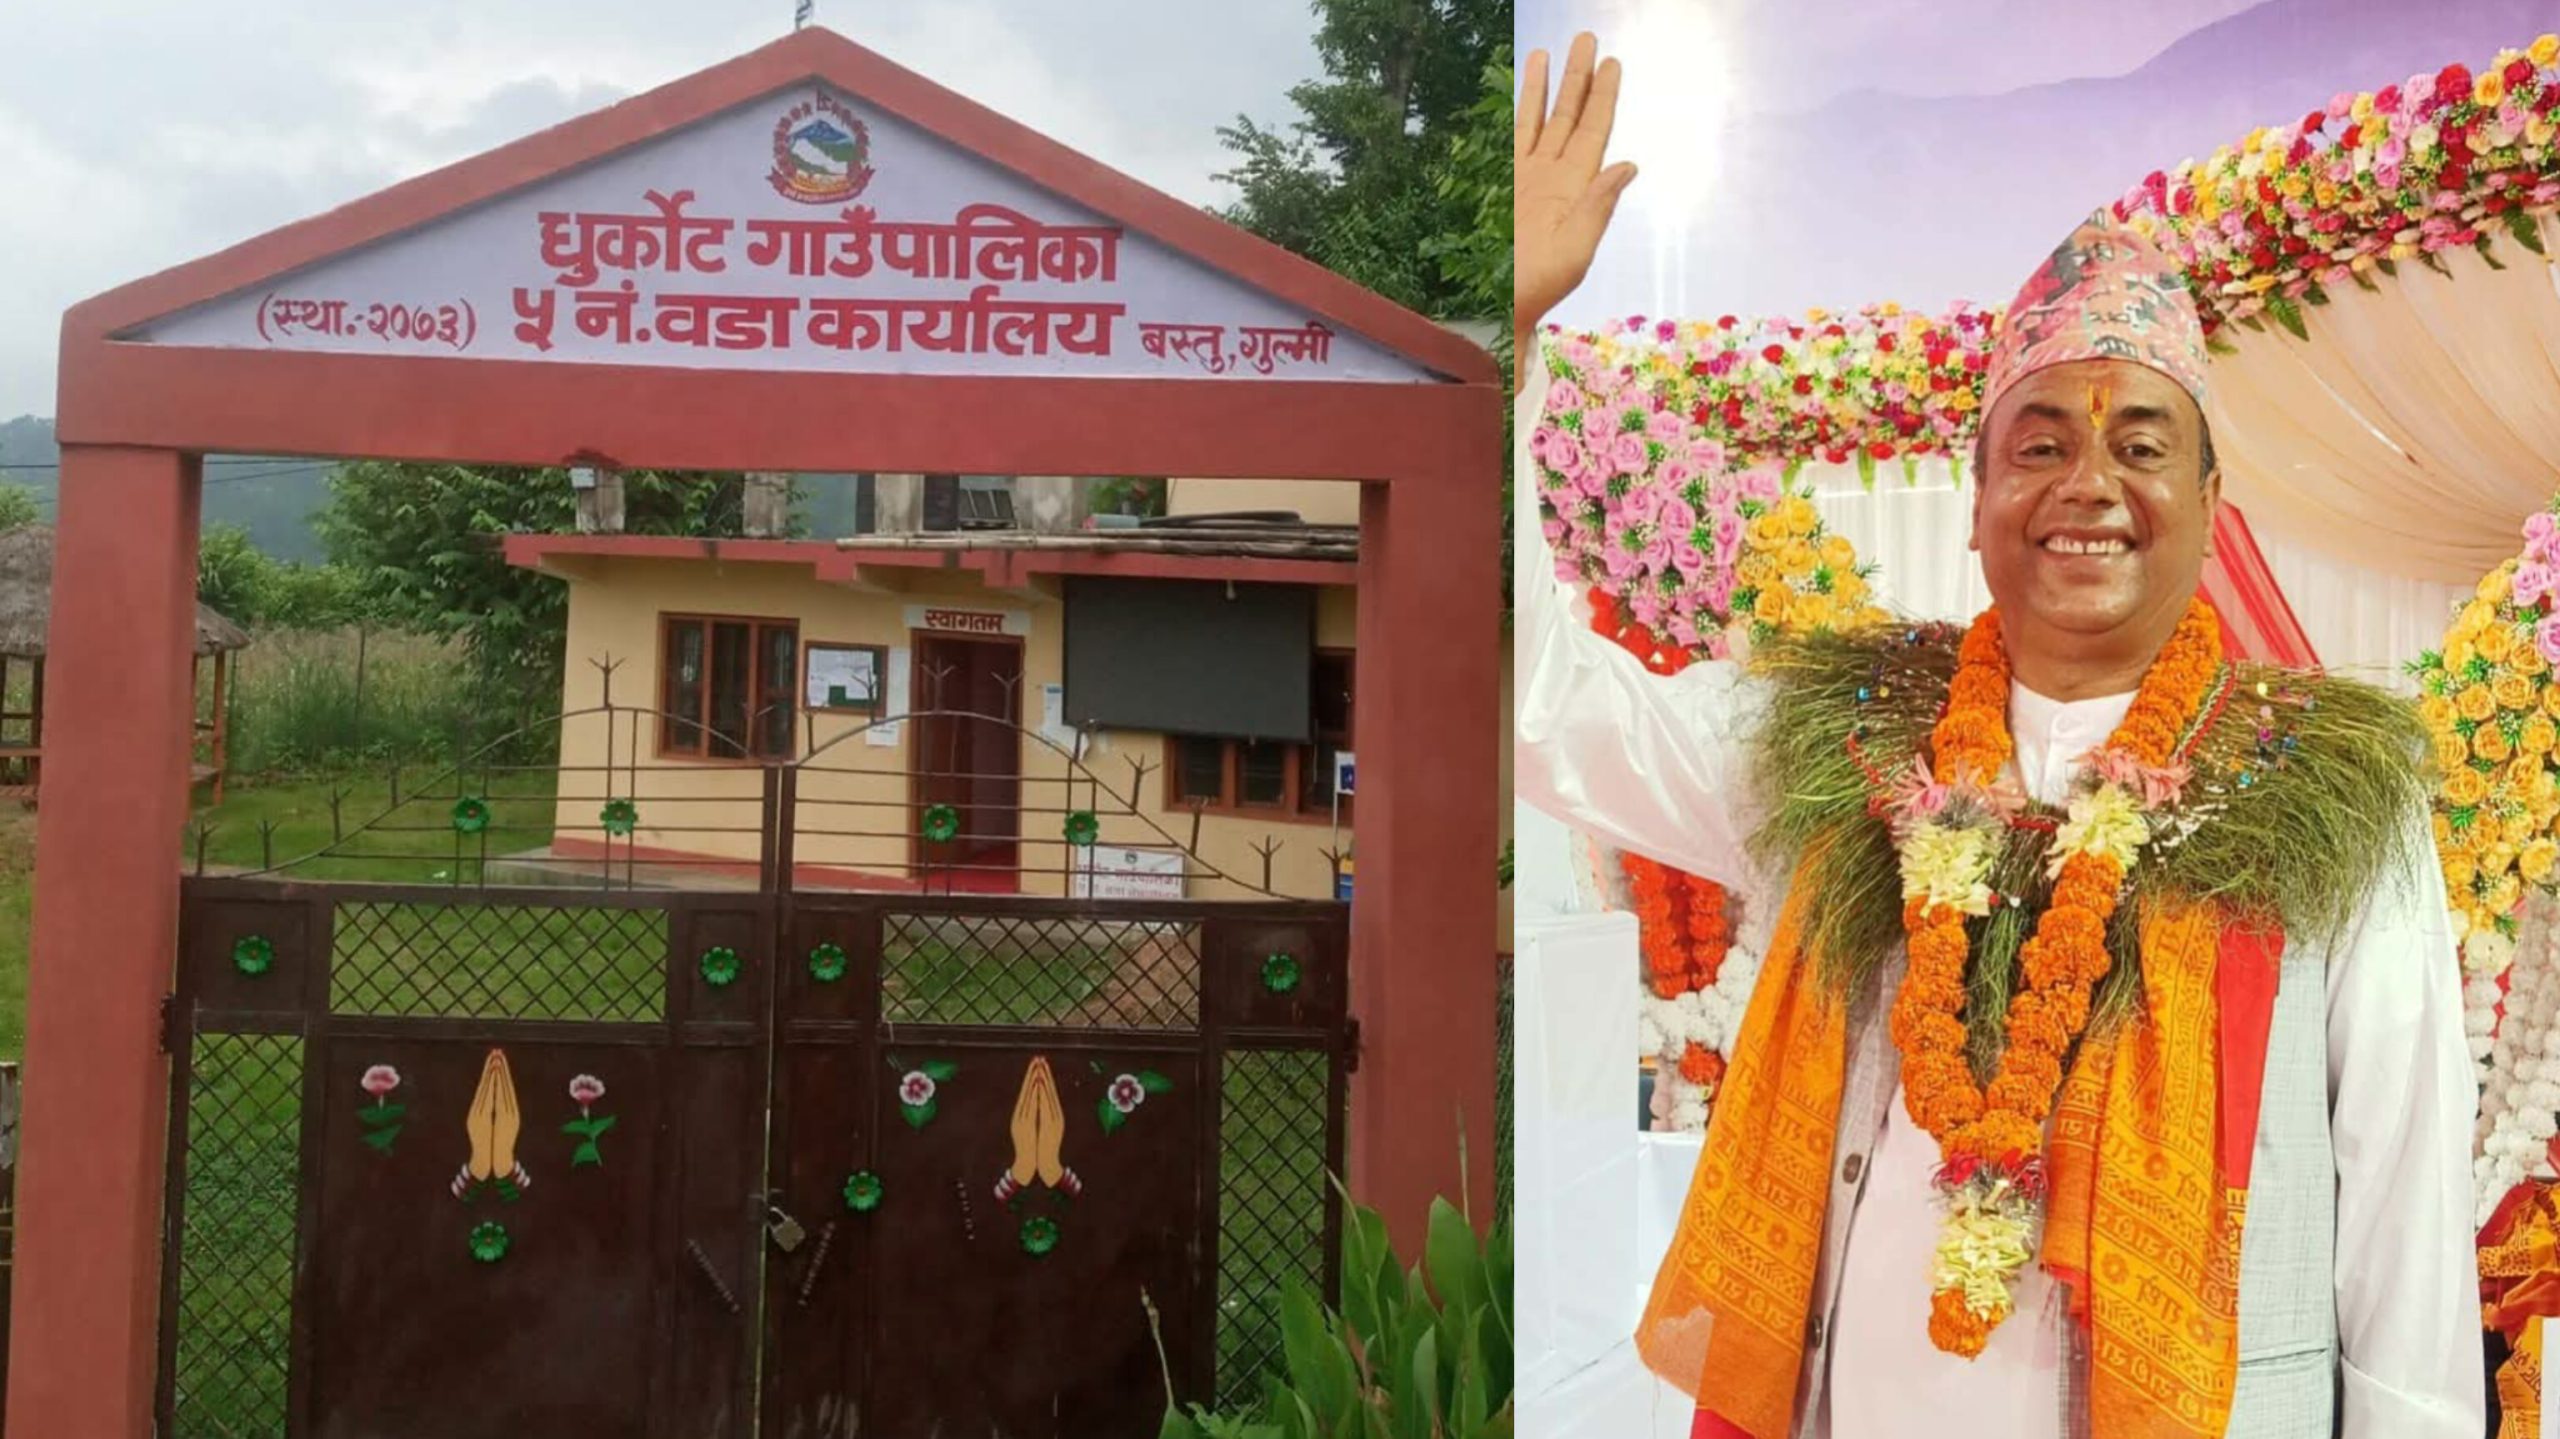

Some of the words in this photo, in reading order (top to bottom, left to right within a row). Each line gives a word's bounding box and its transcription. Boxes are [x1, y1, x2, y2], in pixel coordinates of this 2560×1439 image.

[538, 189, 734, 287] धुर्कोट
[746, 204, 1123, 283] गाउँपालिका
[513, 287, 556, 352] ५
[807, 284, 1126, 356] कार्यालय
